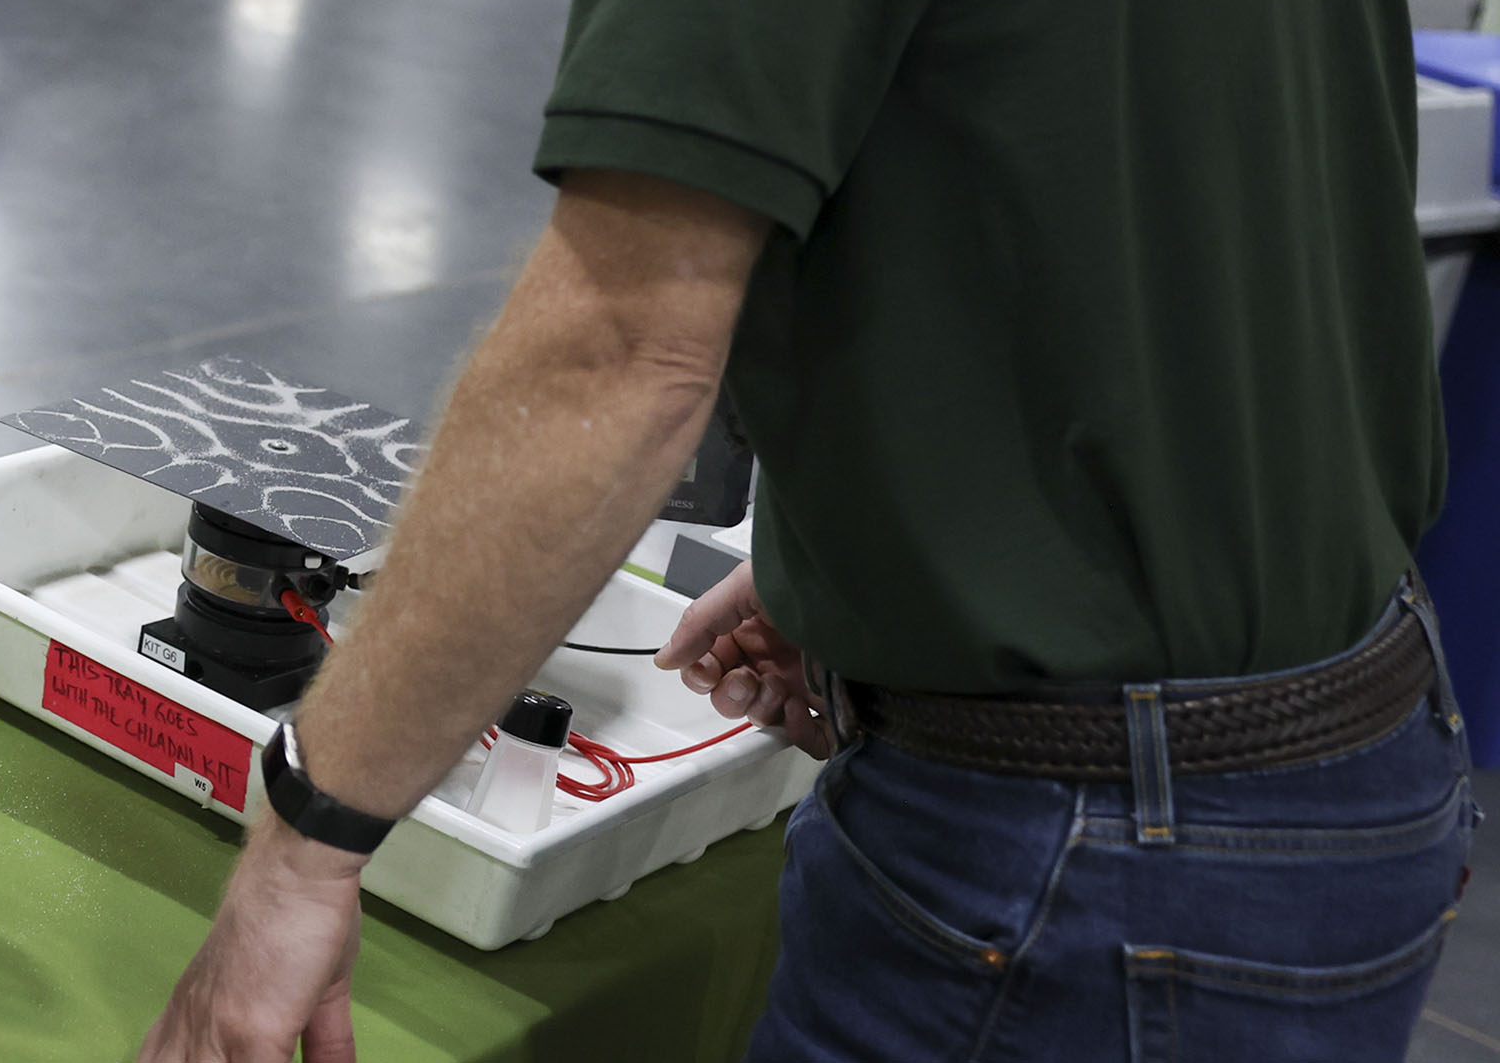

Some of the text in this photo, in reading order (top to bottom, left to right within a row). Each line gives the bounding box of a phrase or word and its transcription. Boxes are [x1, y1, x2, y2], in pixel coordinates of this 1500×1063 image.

[144, 638, 177, 663] KIT G6
[54, 647, 198, 736] THIS TRAY GOES
[53, 676, 243, 789] WITH THE CHLADNI KIT
[194, 777, 207, 792] W5
